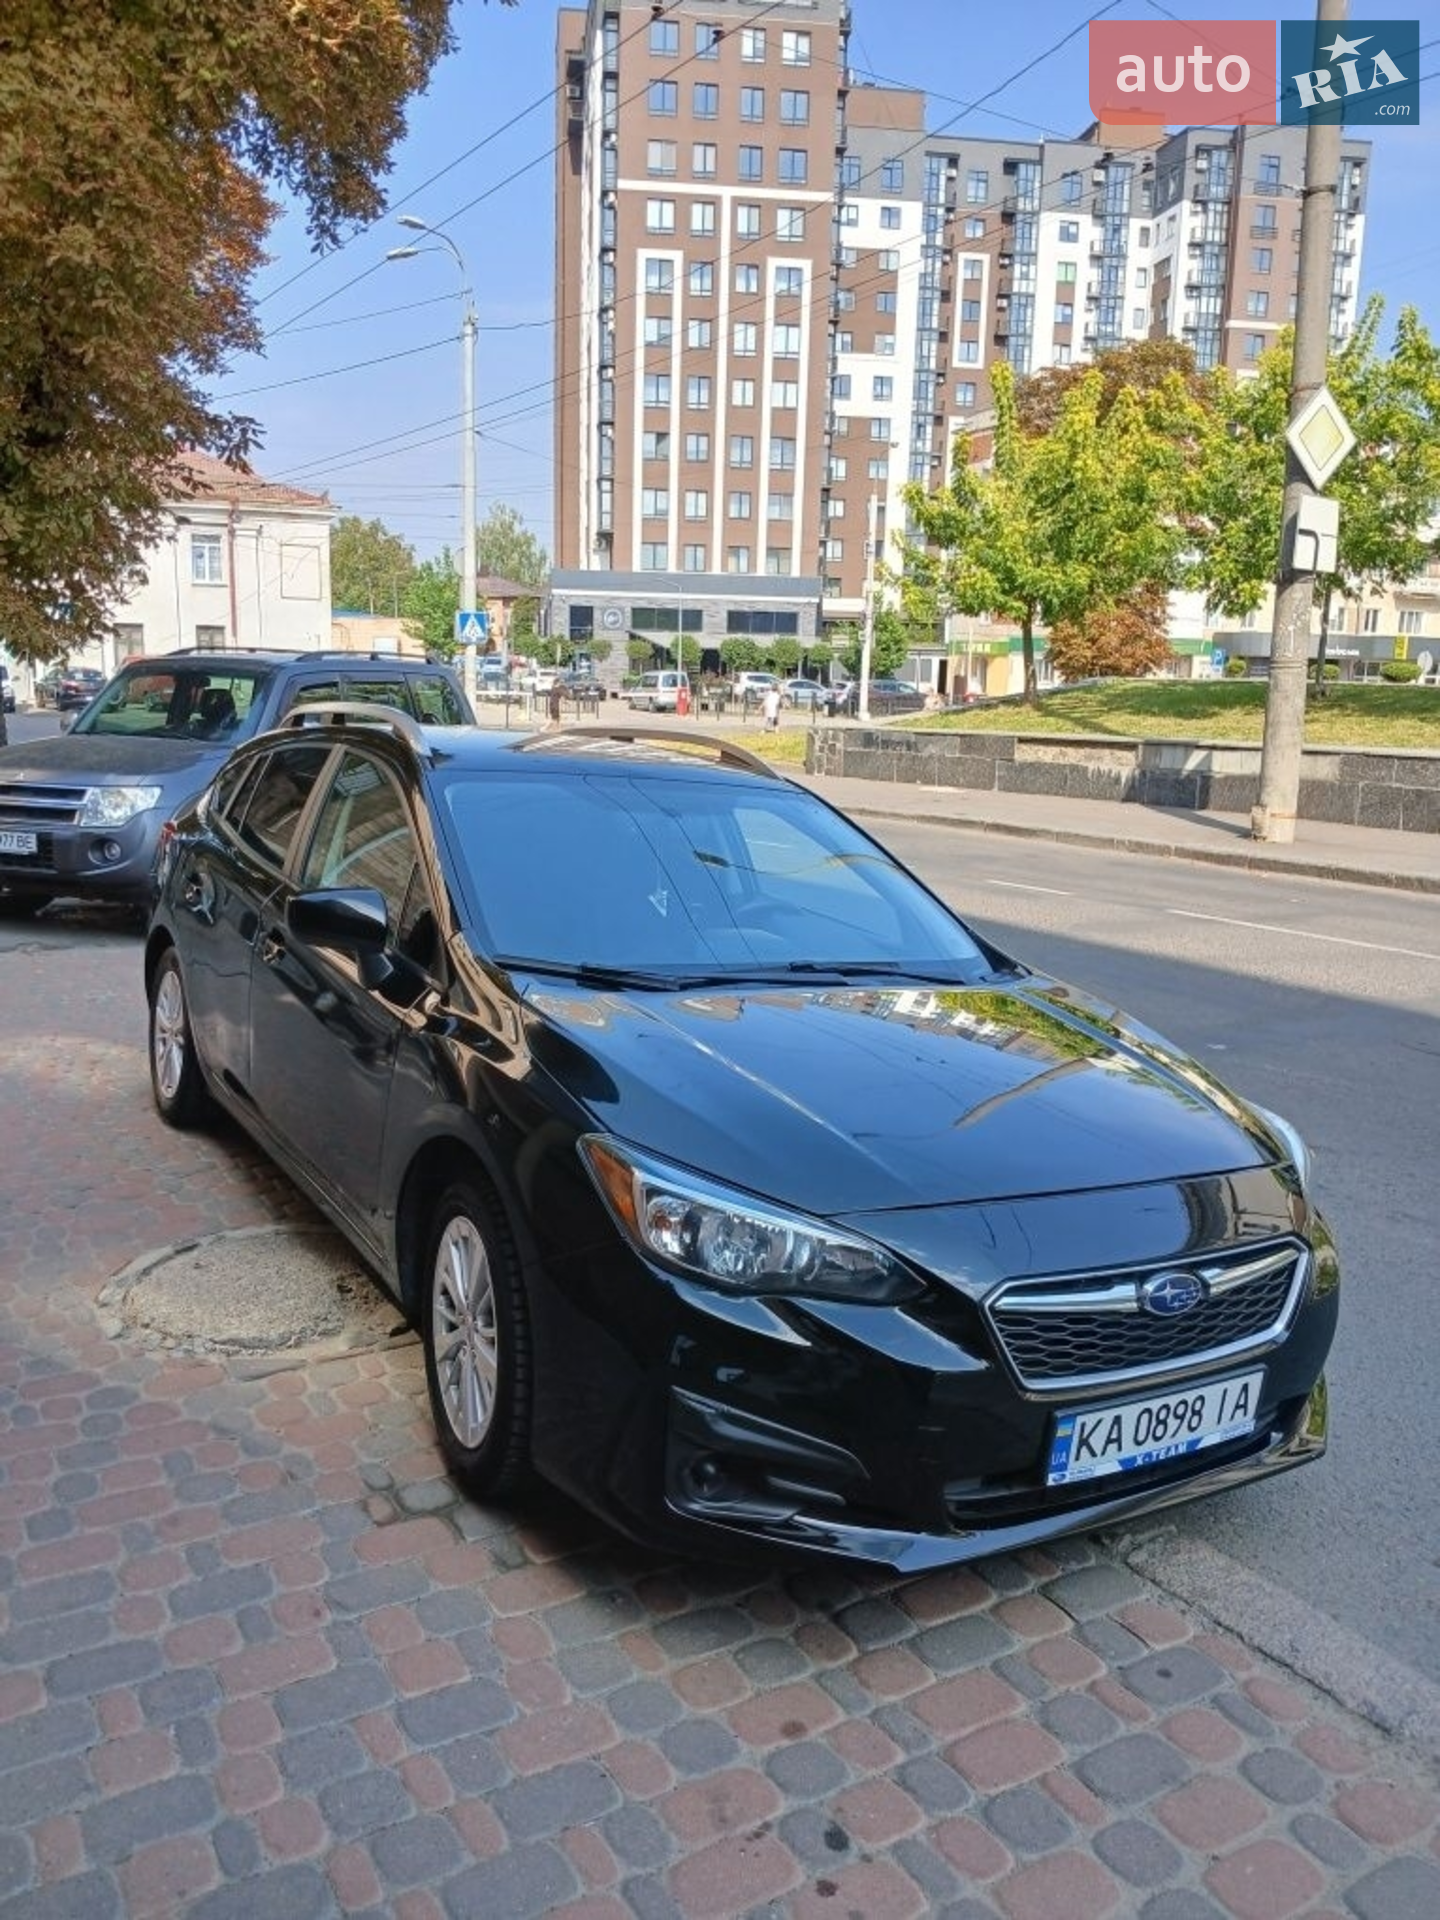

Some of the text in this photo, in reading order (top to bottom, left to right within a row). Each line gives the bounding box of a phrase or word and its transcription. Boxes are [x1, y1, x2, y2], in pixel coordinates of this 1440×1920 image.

[1075, 1415, 1122, 1461] KA
[1133, 1395, 1205, 1446] 0898
[1217, 1382, 1248, 1425] IA
[1051, 1451, 1066, 1465] UA
